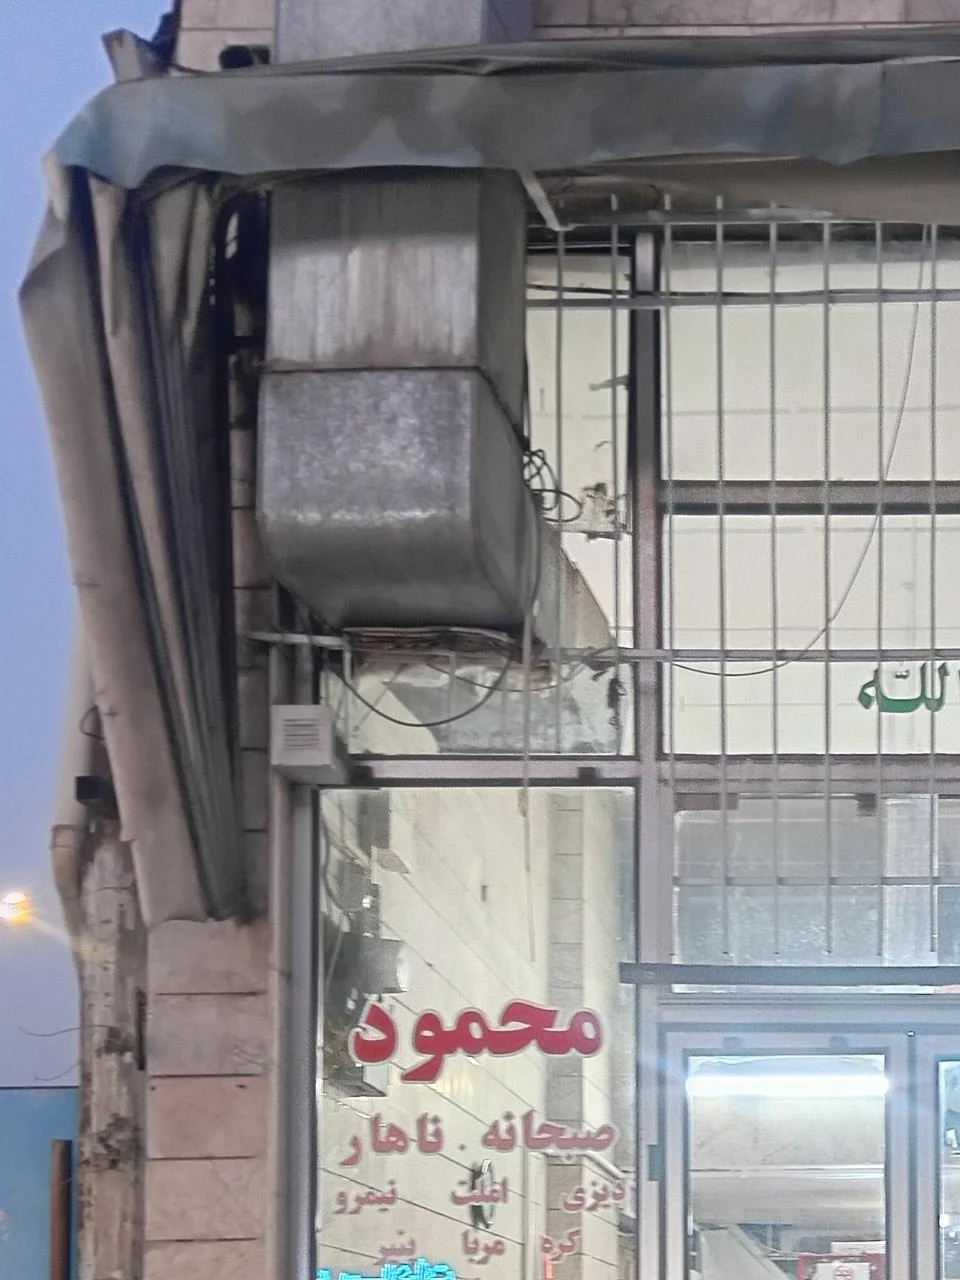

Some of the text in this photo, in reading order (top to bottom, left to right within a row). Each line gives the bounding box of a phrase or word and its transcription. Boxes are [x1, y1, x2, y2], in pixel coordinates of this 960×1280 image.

[353, 999, 604, 1082] محمود
[339, 1109, 619, 1167] صبحانه ناهار
[334, 1177, 627, 1214] دیزی املت نیمرو
[461, 1229, 506, 1265] مربا
[541, 1226, 582, 1262] کره
